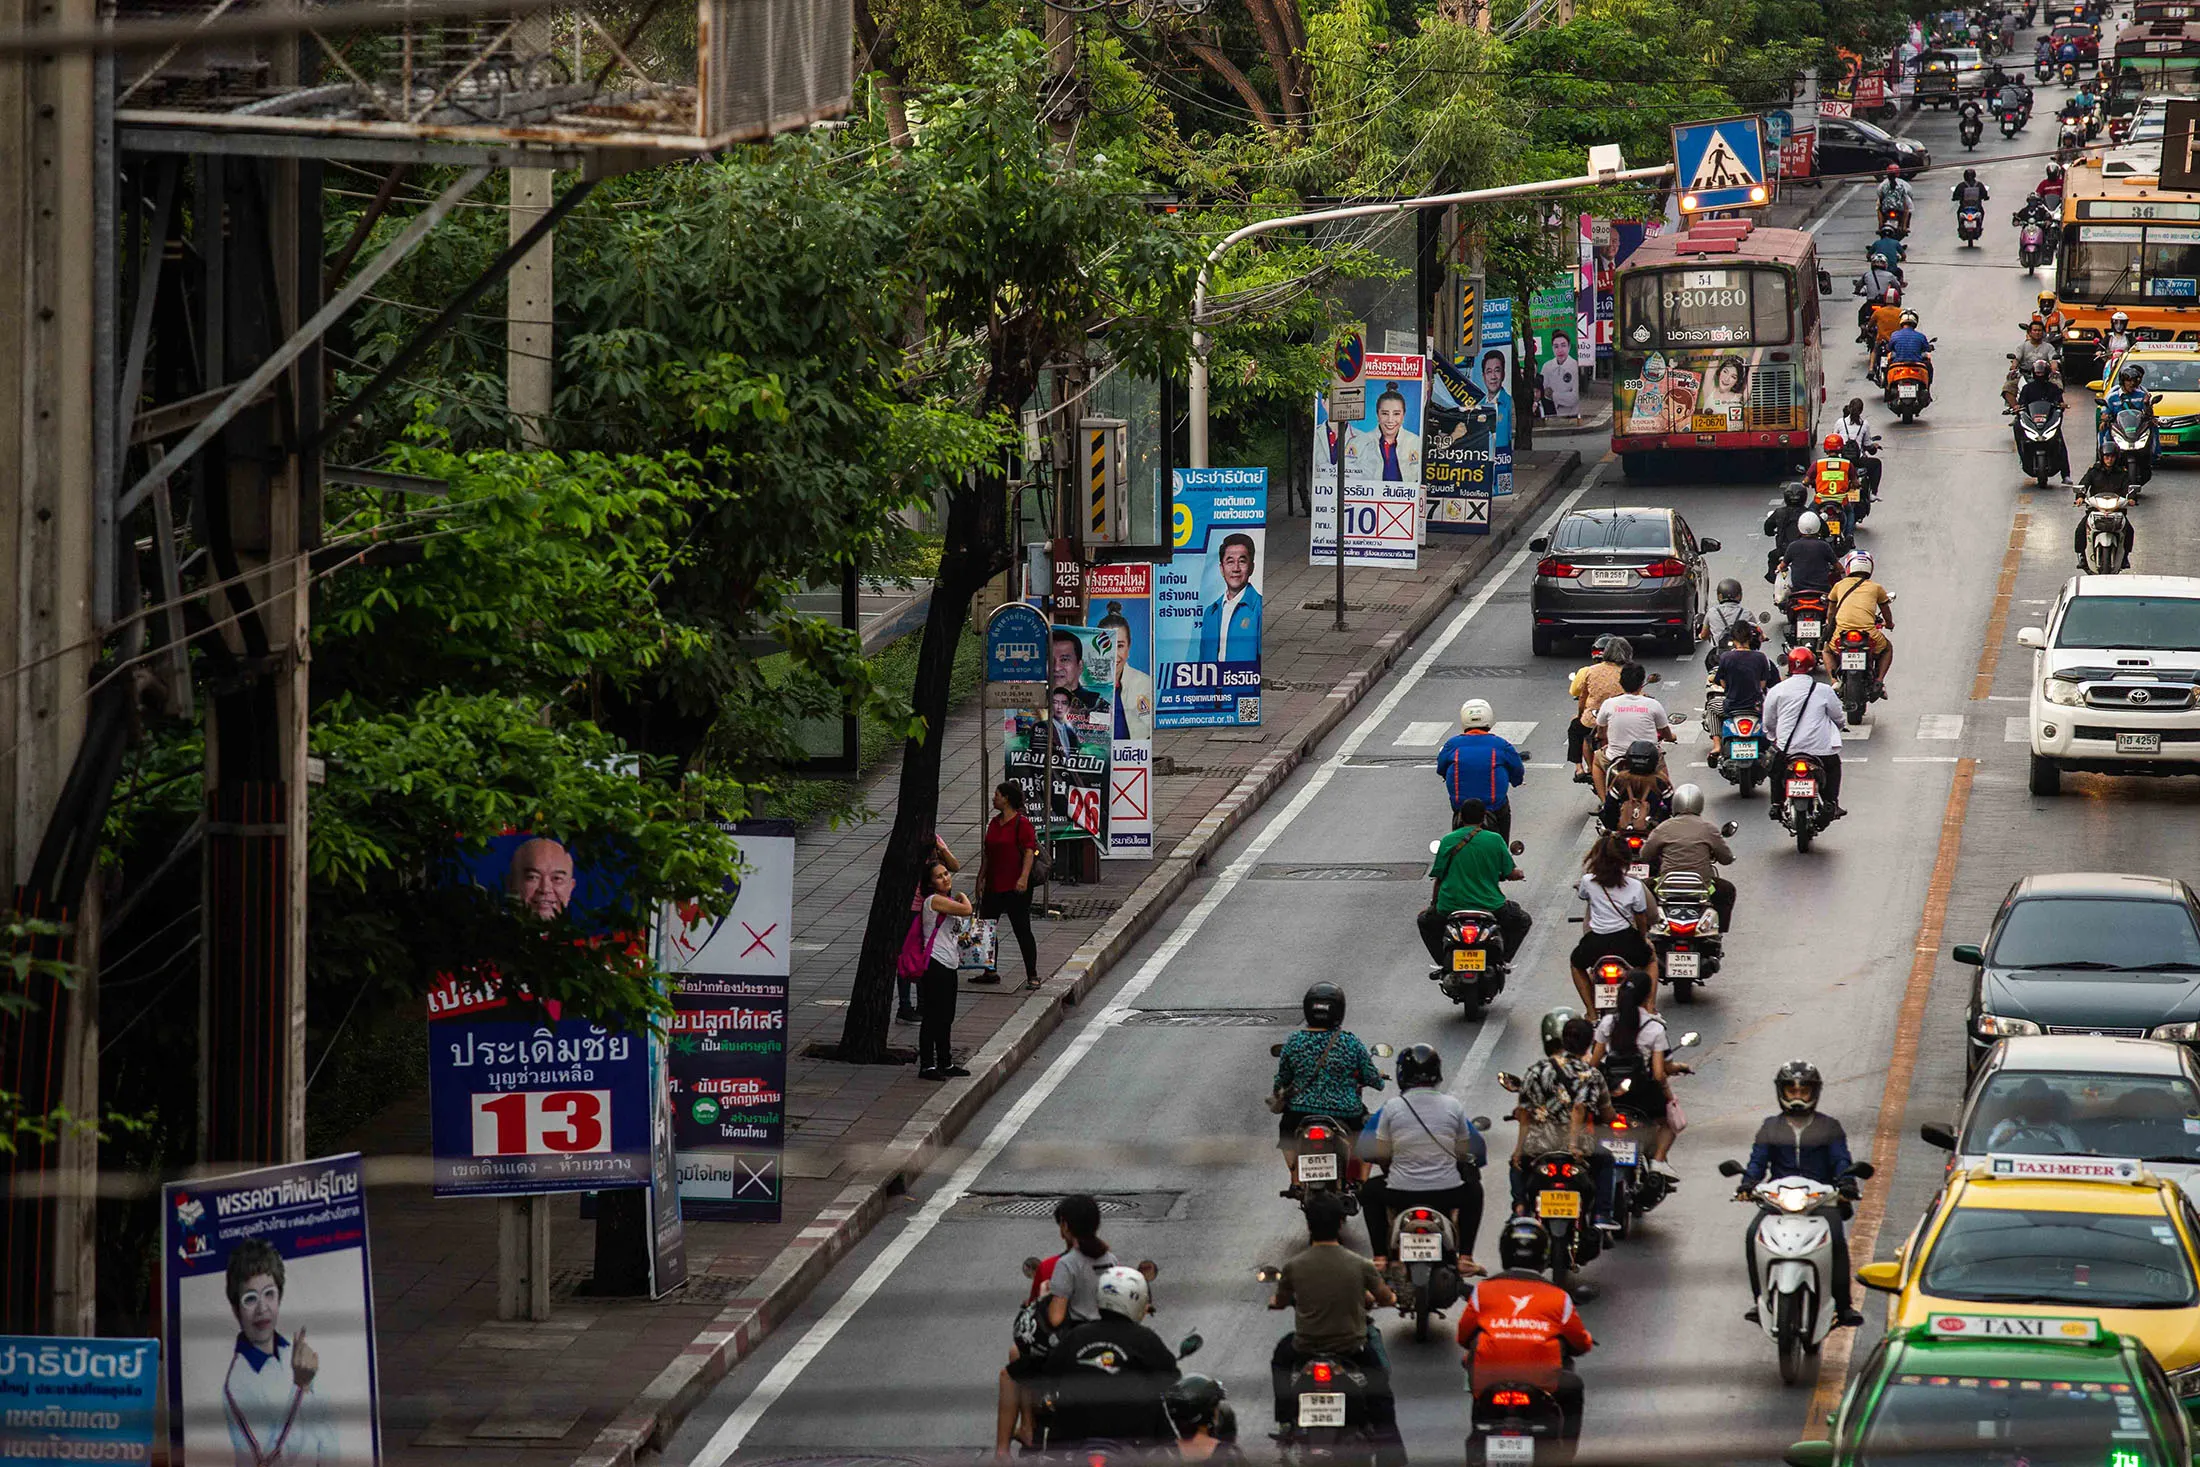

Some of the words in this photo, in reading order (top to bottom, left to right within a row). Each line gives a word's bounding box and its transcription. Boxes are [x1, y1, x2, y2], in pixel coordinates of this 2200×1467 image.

[1820, 102, 1833, 112] 18
[2132, 206, 2154, 218] 36
[1698, 274, 1712, 286] 54
[1662, 288, 1747, 309] 8-80480
[2148, 342, 2188, 350] TAXI-METER
[1625, 380, 1644, 390] 39B
[1186, 470, 1265, 485] ประชาธิปัตย์
[1315, 485, 1333, 496] นาง
[1343, 484, 1374, 497] รรธิมา
[1382, 484, 1416, 501] สันติสุข
[1828, 481, 1837, 494] 9
[1213, 495, 1256, 507] เขตดินแดง
[1213, 507, 1265, 520] เขตห้วยขวาง
[1330, 506, 1336, 514] 5
[1426, 501, 1441, 520] 7
[1173, 503, 1193, 547] 9
[1344, 506, 1377, 535] 10
[1056, 561, 1080, 574] DDG
[1056, 574, 1080, 587] 425
[1159, 571, 1188, 585] แก้จน
[1123, 586, 1145, 594] PARTY
[1158, 587, 1199, 602] สร้างคน
[1056, 597, 1081, 609] 3DL
[1158, 603, 1204, 618] สร้างชาติ
[1175, 663, 1219, 687] ธนา
[1223, 670, 1261, 686] ชีรวินิจ
[1175, 694, 1181, 702] 5
[1158, 715, 1235, 726] www.democrat.or.th
[2135, 735, 2158, 746] 4259
[1069, 787, 1100, 836] 26
[691, 1006, 784, 1037] ปลูกได้เสรี
[450, 1024, 630, 1068] ประเดิมชัย
[487, 1065, 595, 1092] บุญช่วยเหลือ
[697, 1077, 718, 1094] ขับ
[719, 1079, 759, 1094] Grab
[720, 1092, 781, 1110] ถูกกฎหมาย
[480, 1091, 603, 1155] 13
[719, 1123, 768, 1139] ให้คนไทย
[451, 1158, 537, 1177] เขตดินแดง
[557, 1154, 632, 1172] ห้วยขวาง
[2016, 1162, 2115, 1176] TAXI-METER
[216, 1168, 358, 1217] พรรคชาติพันธุ์ไทย
[1490, 1317, 1550, 1332] LALAMOVE
[1979, 1317, 2044, 1336] TAXI
[5, 1404, 121, 1430] เขตดินแดง
